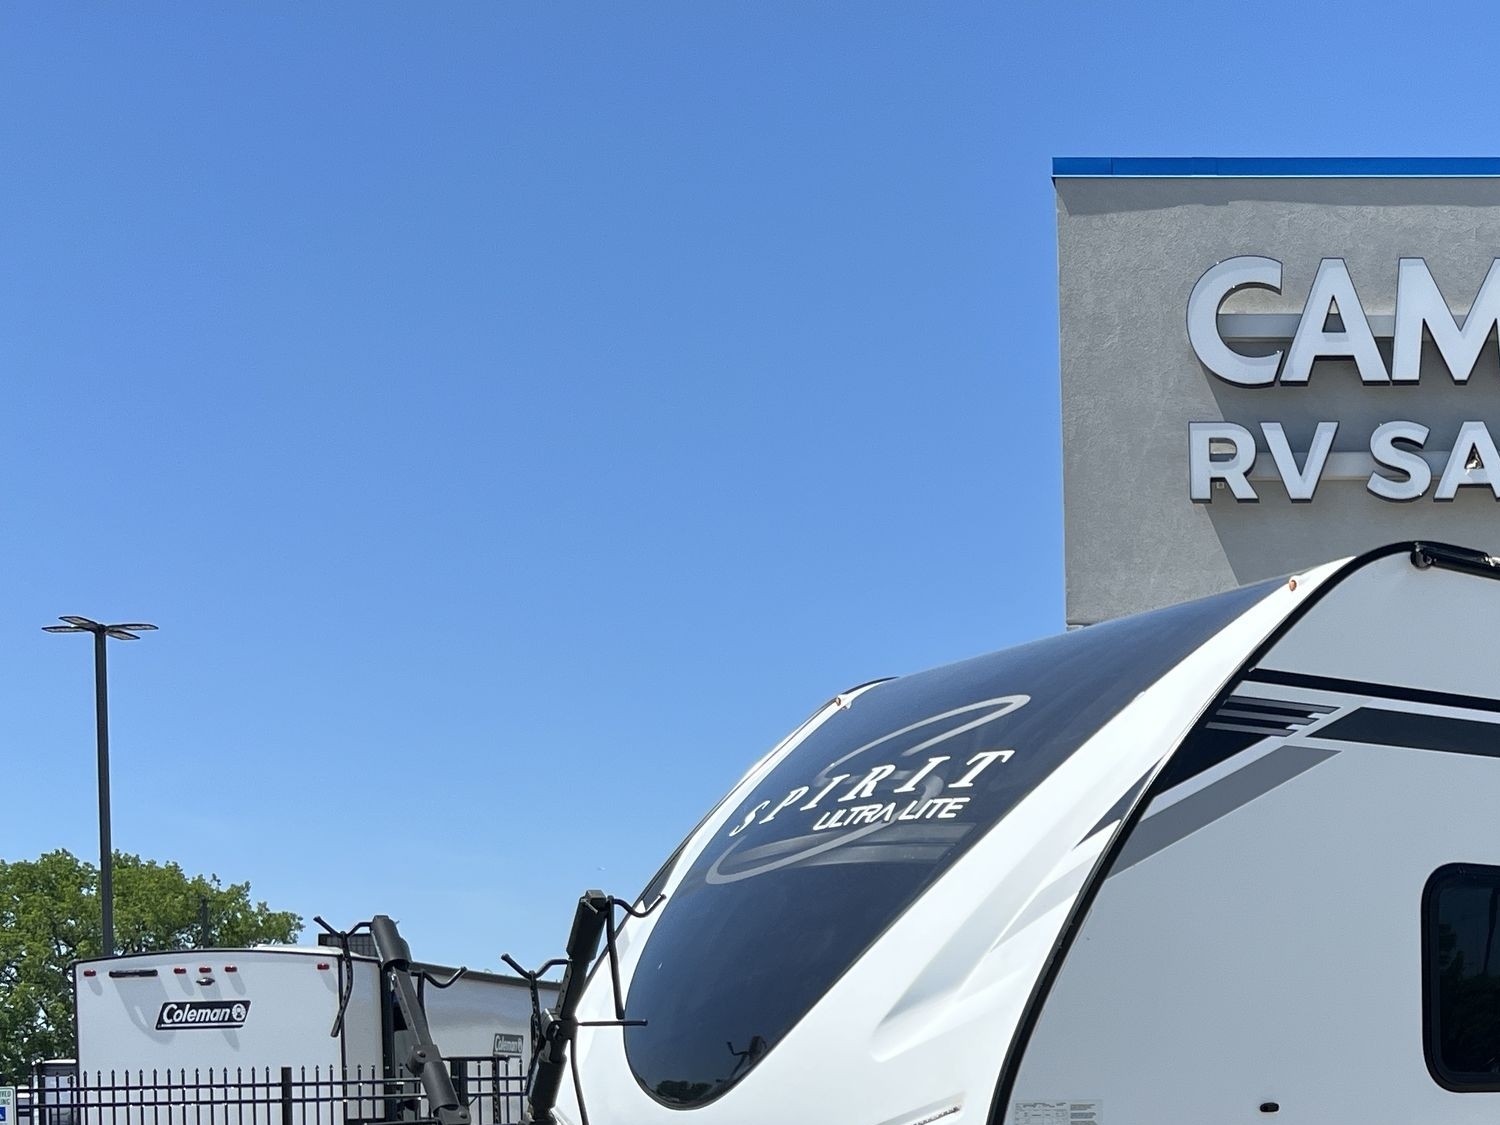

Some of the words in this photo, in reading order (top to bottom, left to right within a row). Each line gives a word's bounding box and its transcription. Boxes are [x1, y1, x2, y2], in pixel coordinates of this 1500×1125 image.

[1188, 421, 1339, 502] RV
[729, 749, 1016, 837] SPIRIT
[812, 802, 897, 832] ULTRA
[897, 796, 971, 821] LITE
[162, 1003, 231, 1024] Coleman
